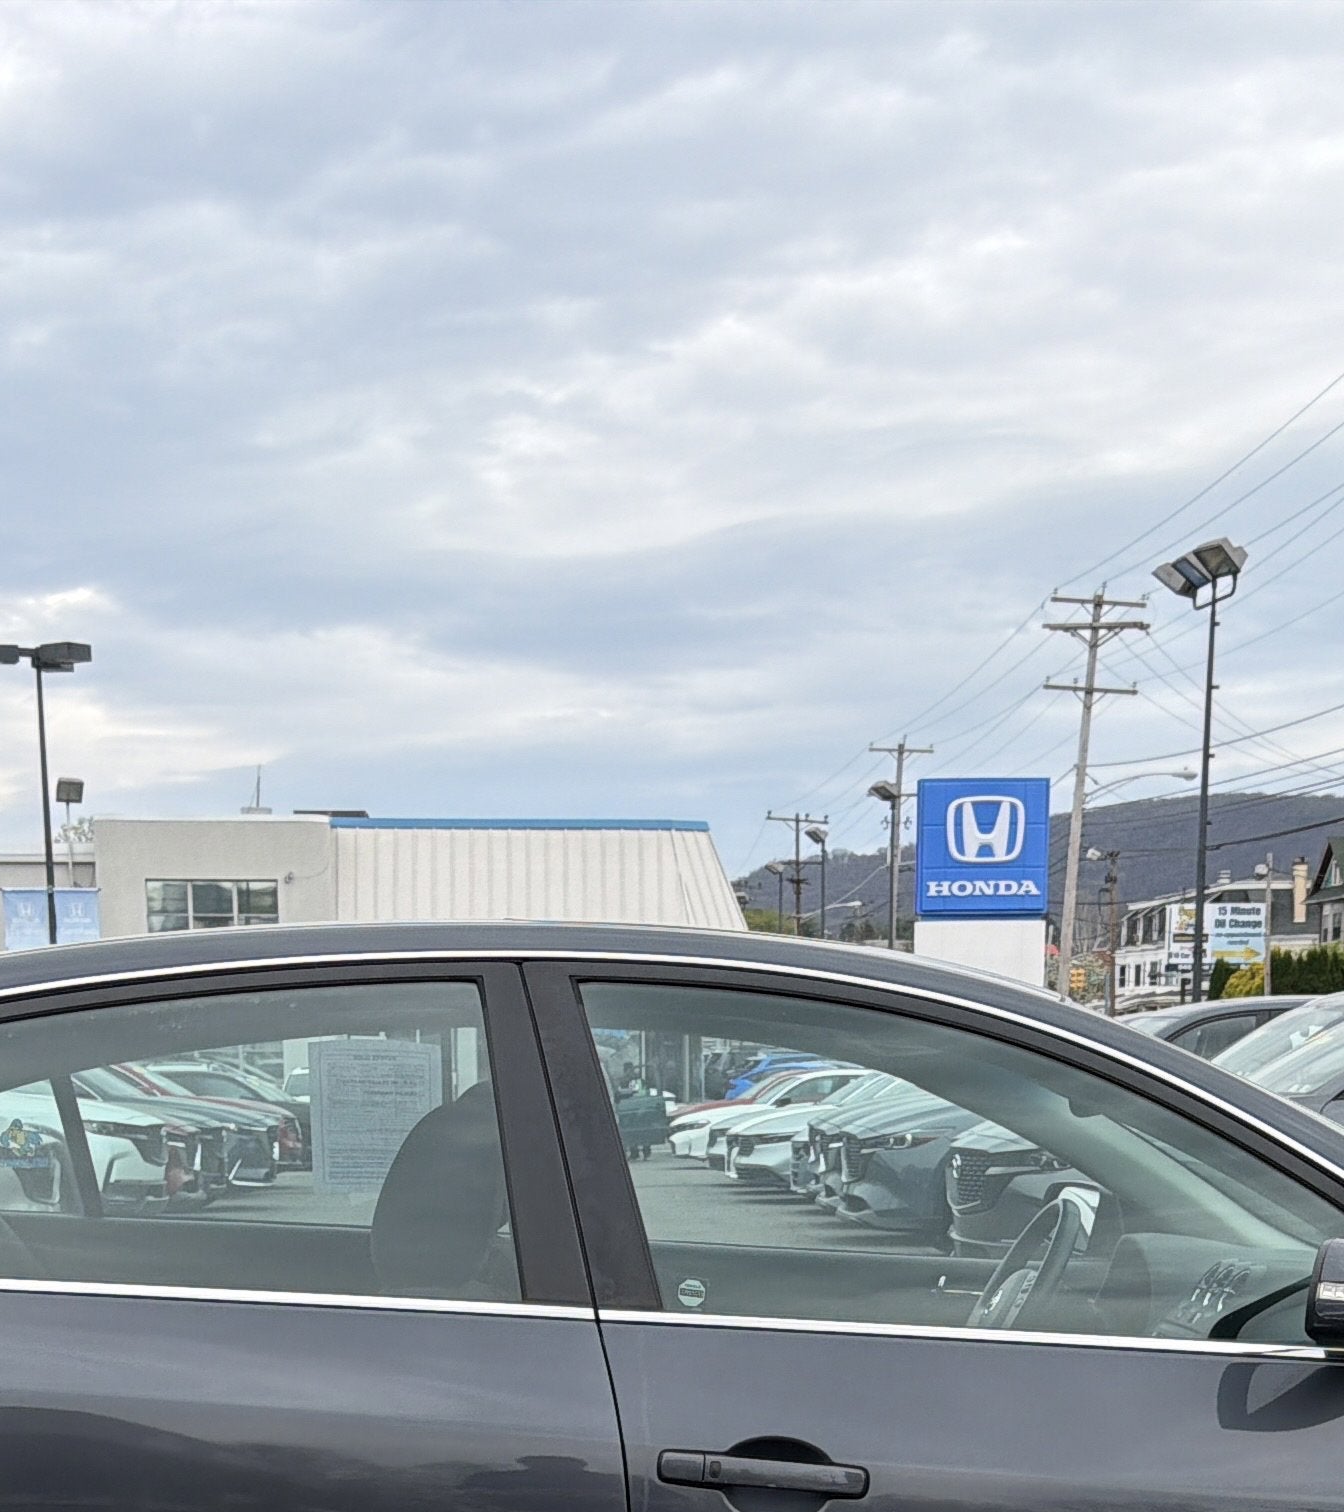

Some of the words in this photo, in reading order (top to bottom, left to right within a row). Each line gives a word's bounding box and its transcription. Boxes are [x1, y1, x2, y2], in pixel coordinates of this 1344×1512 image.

[926, 880, 1041, 897] HONDA
[1217, 907, 1227, 916] 15
[1230, 907, 1261, 916] Minute
[1228, 919, 1263, 929] Change
